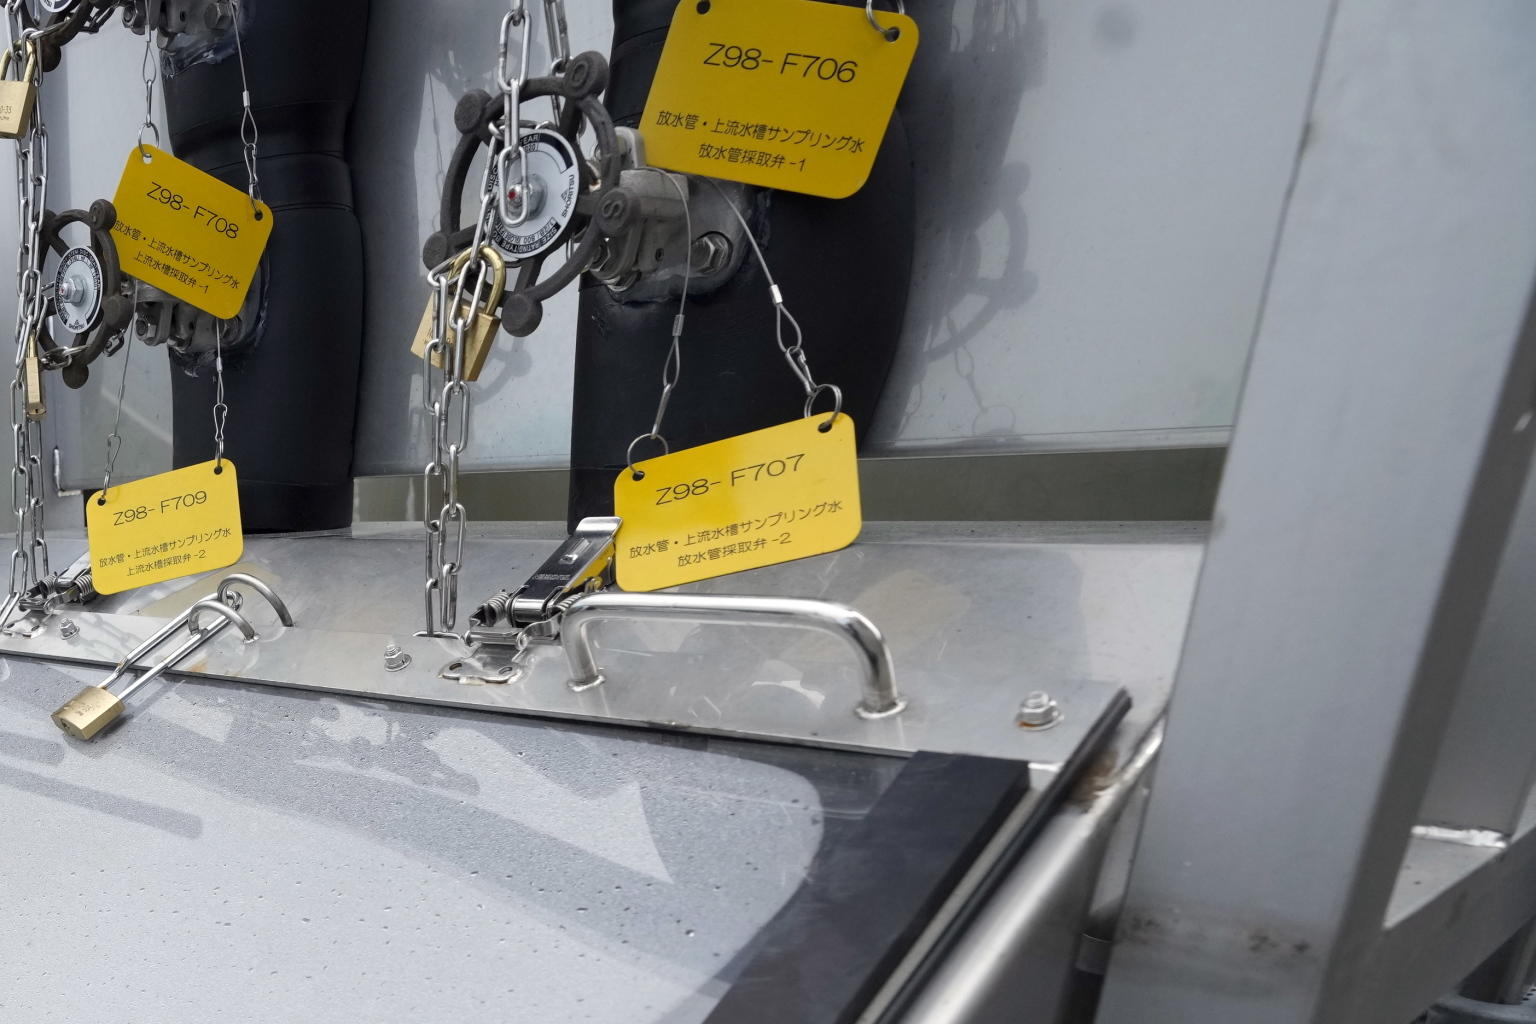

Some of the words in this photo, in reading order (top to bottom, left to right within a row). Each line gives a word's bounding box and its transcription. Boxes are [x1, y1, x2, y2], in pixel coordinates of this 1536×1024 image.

[703, 42, 859, 84] Z98-F706
[655, 110, 864, 154] 放水管・上流水槽サンプリング水
[146, 181, 239, 239] Z98-F708
[655, 453, 807, 506] Z98-F707
[112, 490, 208, 527] Z98-F709
[628, 500, 843, 559] 放水管・上流水槽サンプリング水
